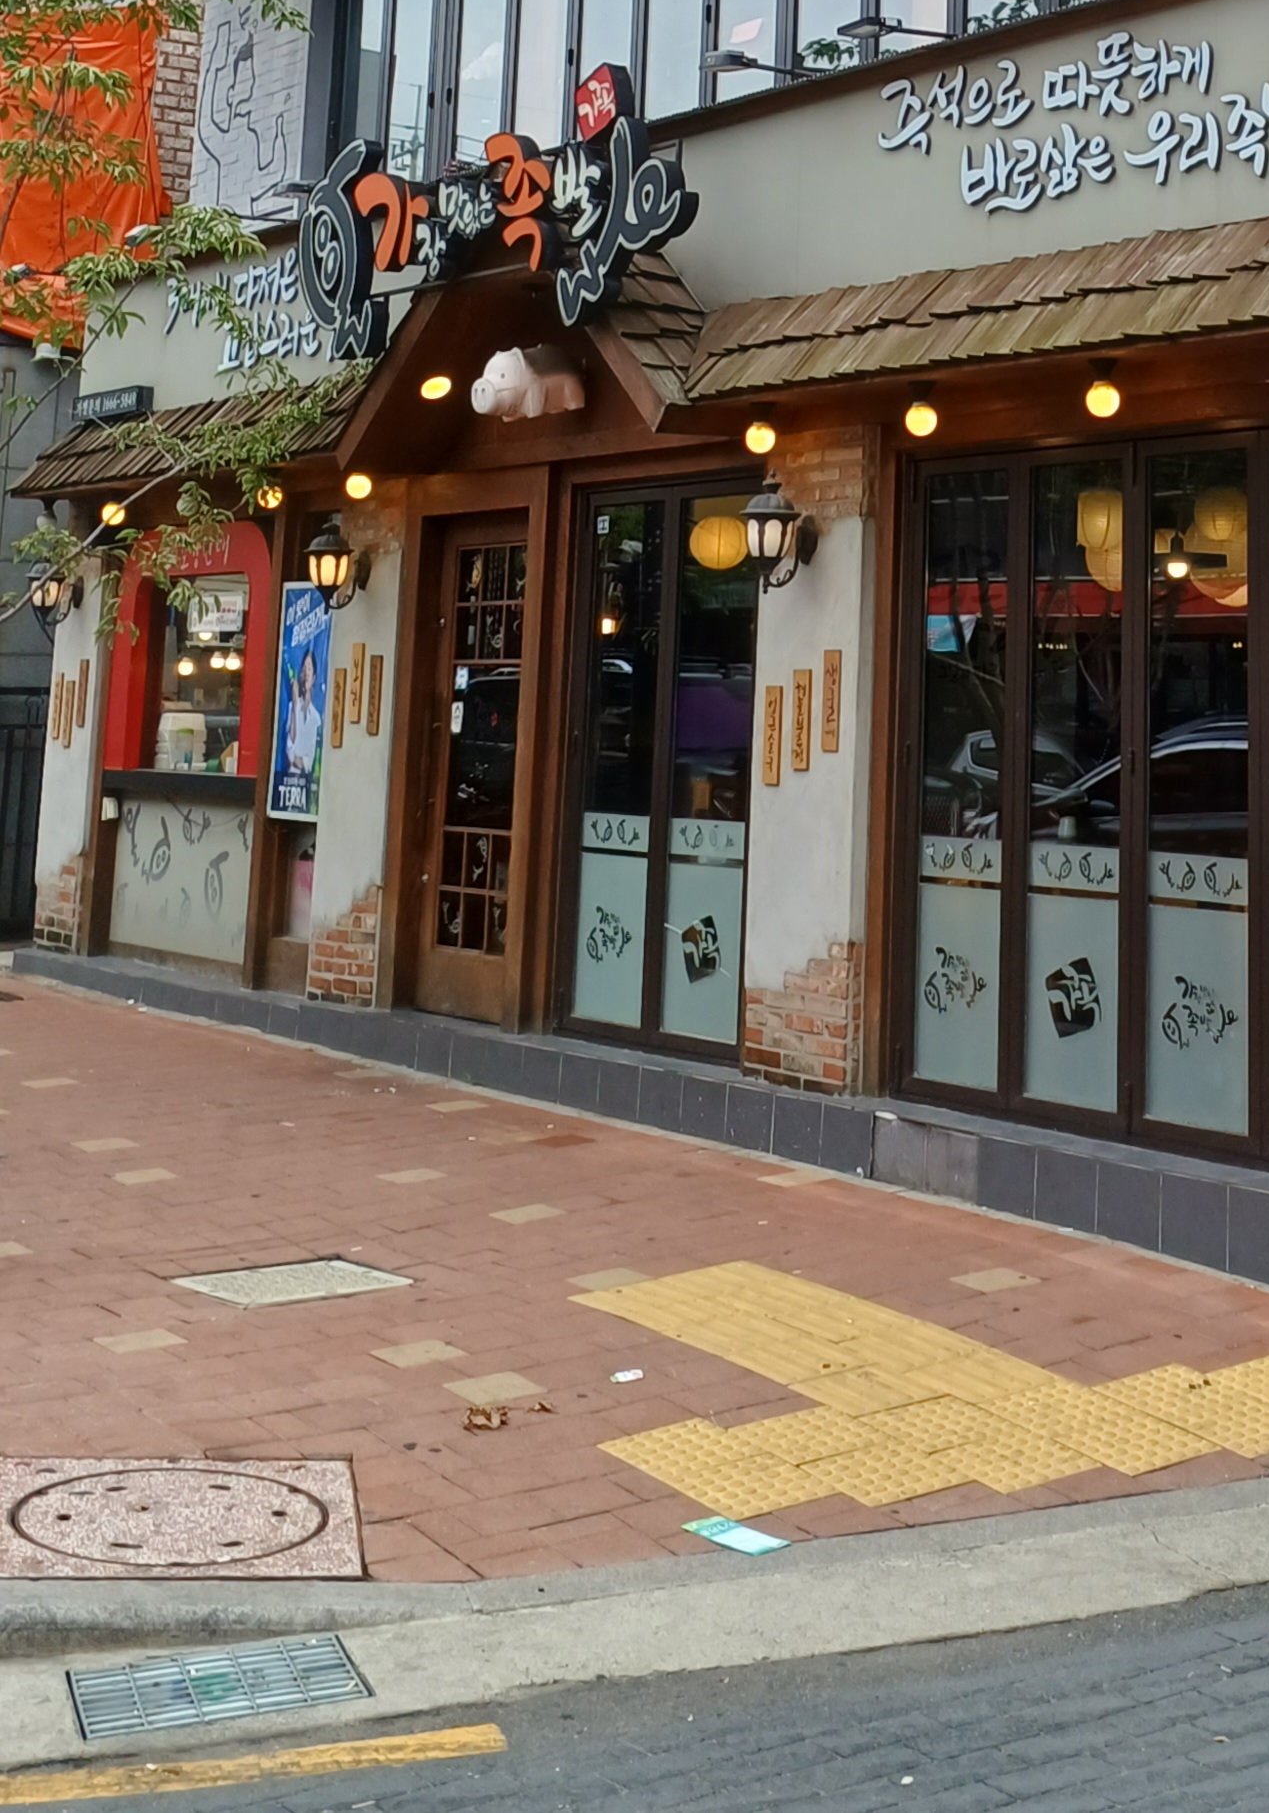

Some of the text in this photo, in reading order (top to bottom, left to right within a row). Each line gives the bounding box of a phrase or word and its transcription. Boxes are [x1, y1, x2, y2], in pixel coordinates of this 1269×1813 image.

[878, 31, 1214, 155] 즉석으로 따뜻하게
[278, 785, 308, 812] TERRA
